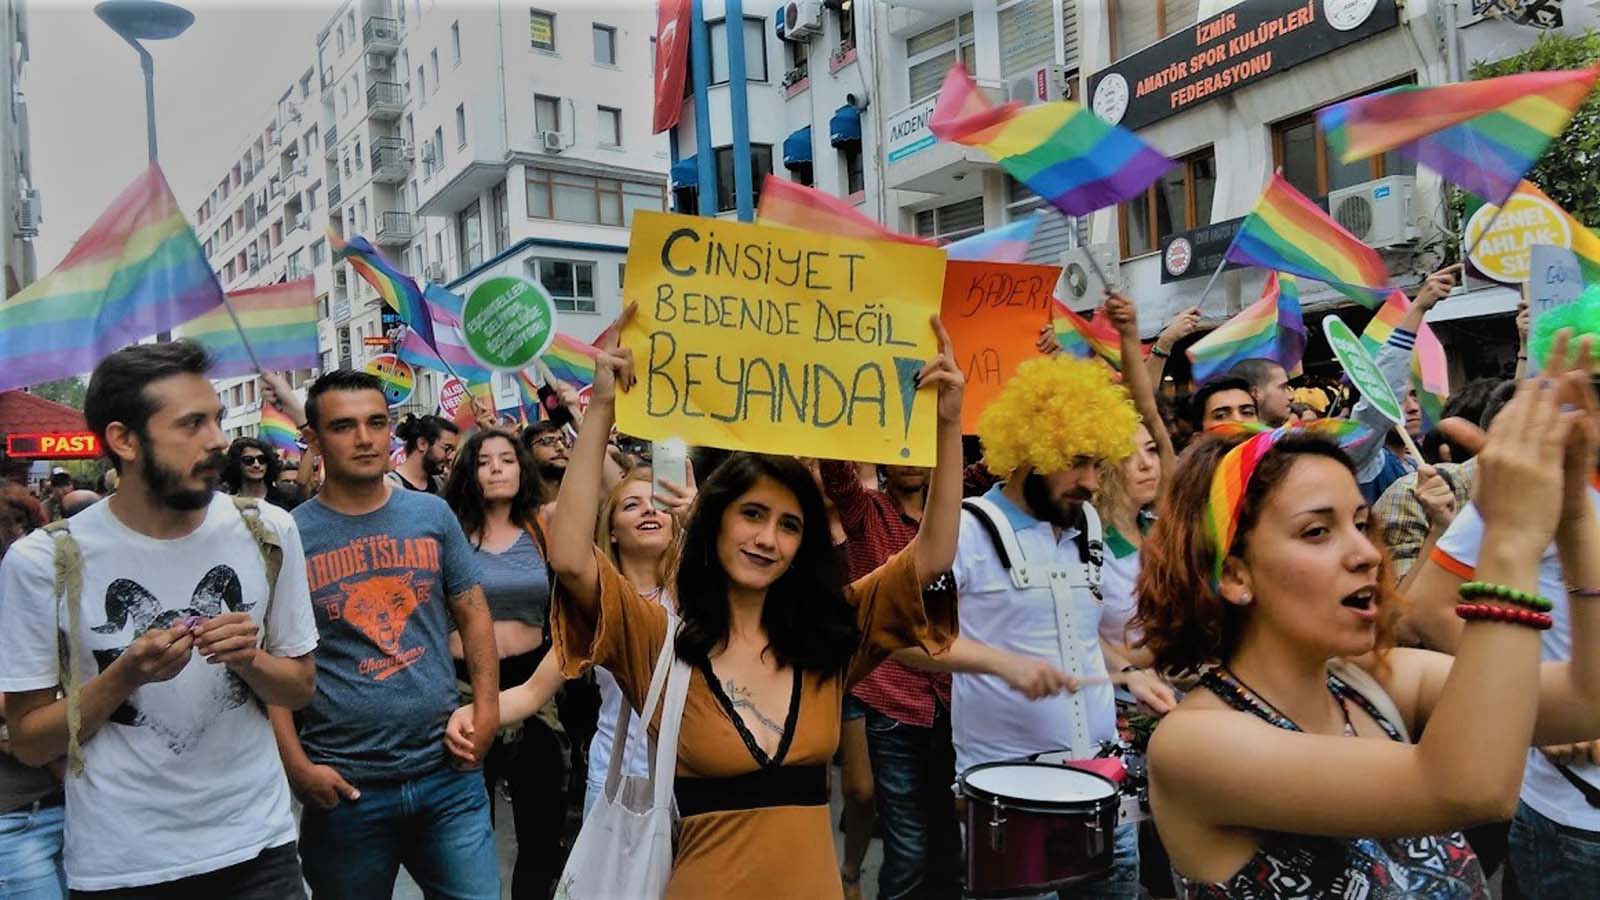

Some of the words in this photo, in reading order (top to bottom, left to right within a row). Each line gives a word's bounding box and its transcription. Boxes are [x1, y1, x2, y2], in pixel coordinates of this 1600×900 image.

[1135, 61, 1188, 98] AMATÖR
[1190, 44, 1226, 74] SPOR
[1229, 1, 1316, 58] KULÜPLERİ
[1196, 12, 1237, 47] İZMİR
[1170, 51, 1273, 109] FEDERASYONU
[661, 228, 865, 292] CİNSİYET
[655, 284, 801, 335] BEDENDE
[814, 299, 918, 348] DEĞİL
[647, 330, 927, 458] BEYANDA!
[370, 537, 441, 573] ISLAND
